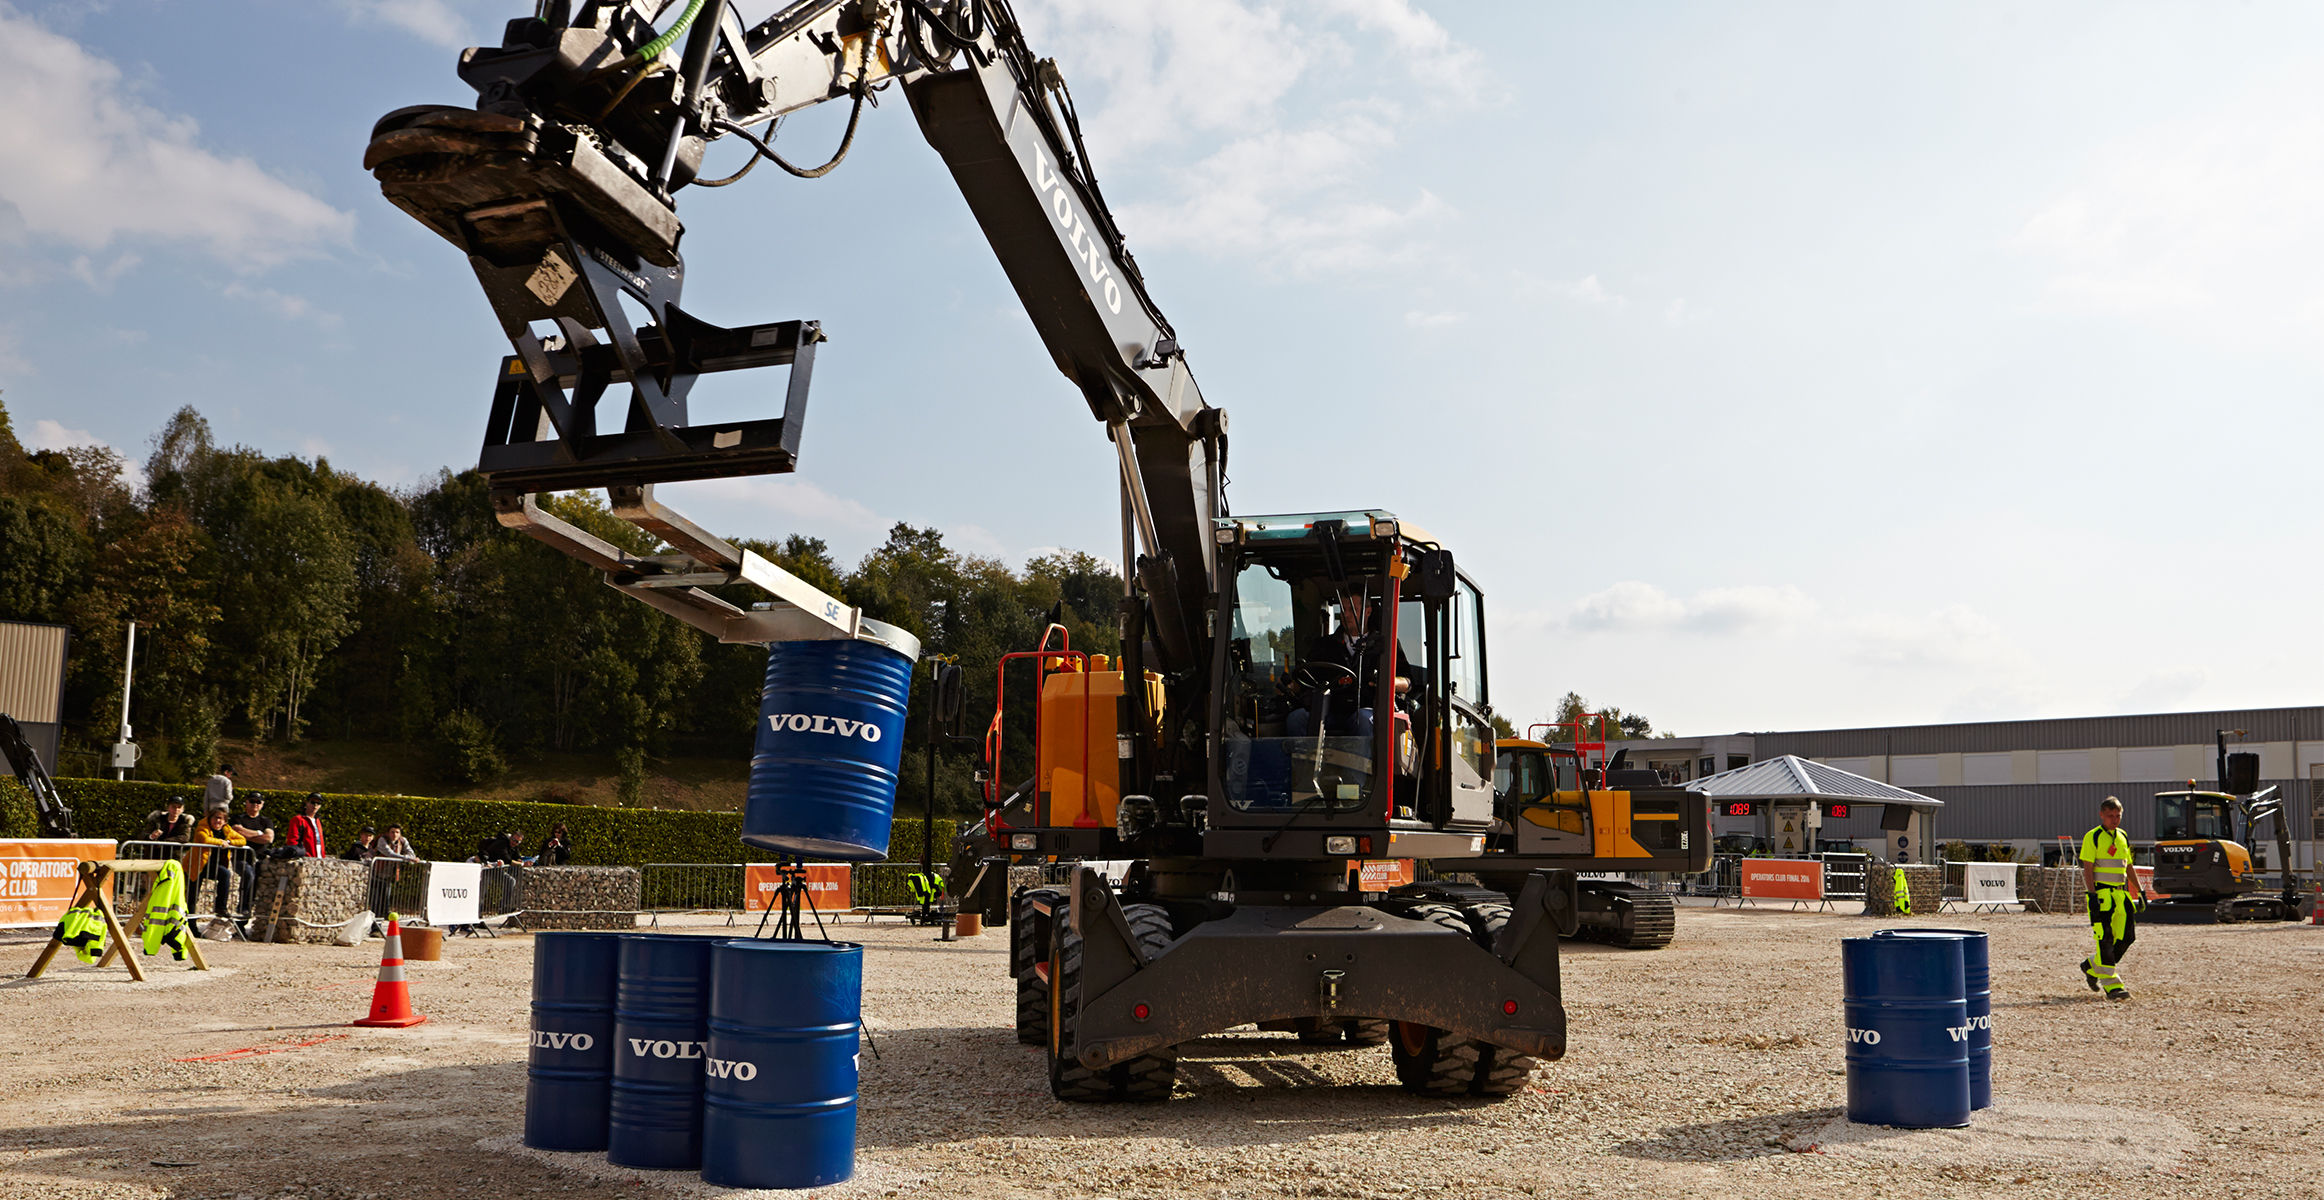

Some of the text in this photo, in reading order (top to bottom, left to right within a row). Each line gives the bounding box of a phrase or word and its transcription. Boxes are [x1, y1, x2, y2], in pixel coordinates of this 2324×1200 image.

[1034, 141, 1121, 315] VOLVO
[599, 250, 647, 290] STEELWRIST
[824, 601, 840, 621] SE
[768, 713, 882, 743] VOLVO
[10, 861, 75, 878] OPERATORS
[9, 879, 38, 896] CLUB
[808, 882, 824, 891] FINAL
[1980, 879, 2005, 887] VOLVO
[442, 888, 468, 899] VOLVO
[0, 904, 12, 912] 016
[706, 1057, 757, 1081] LVO
